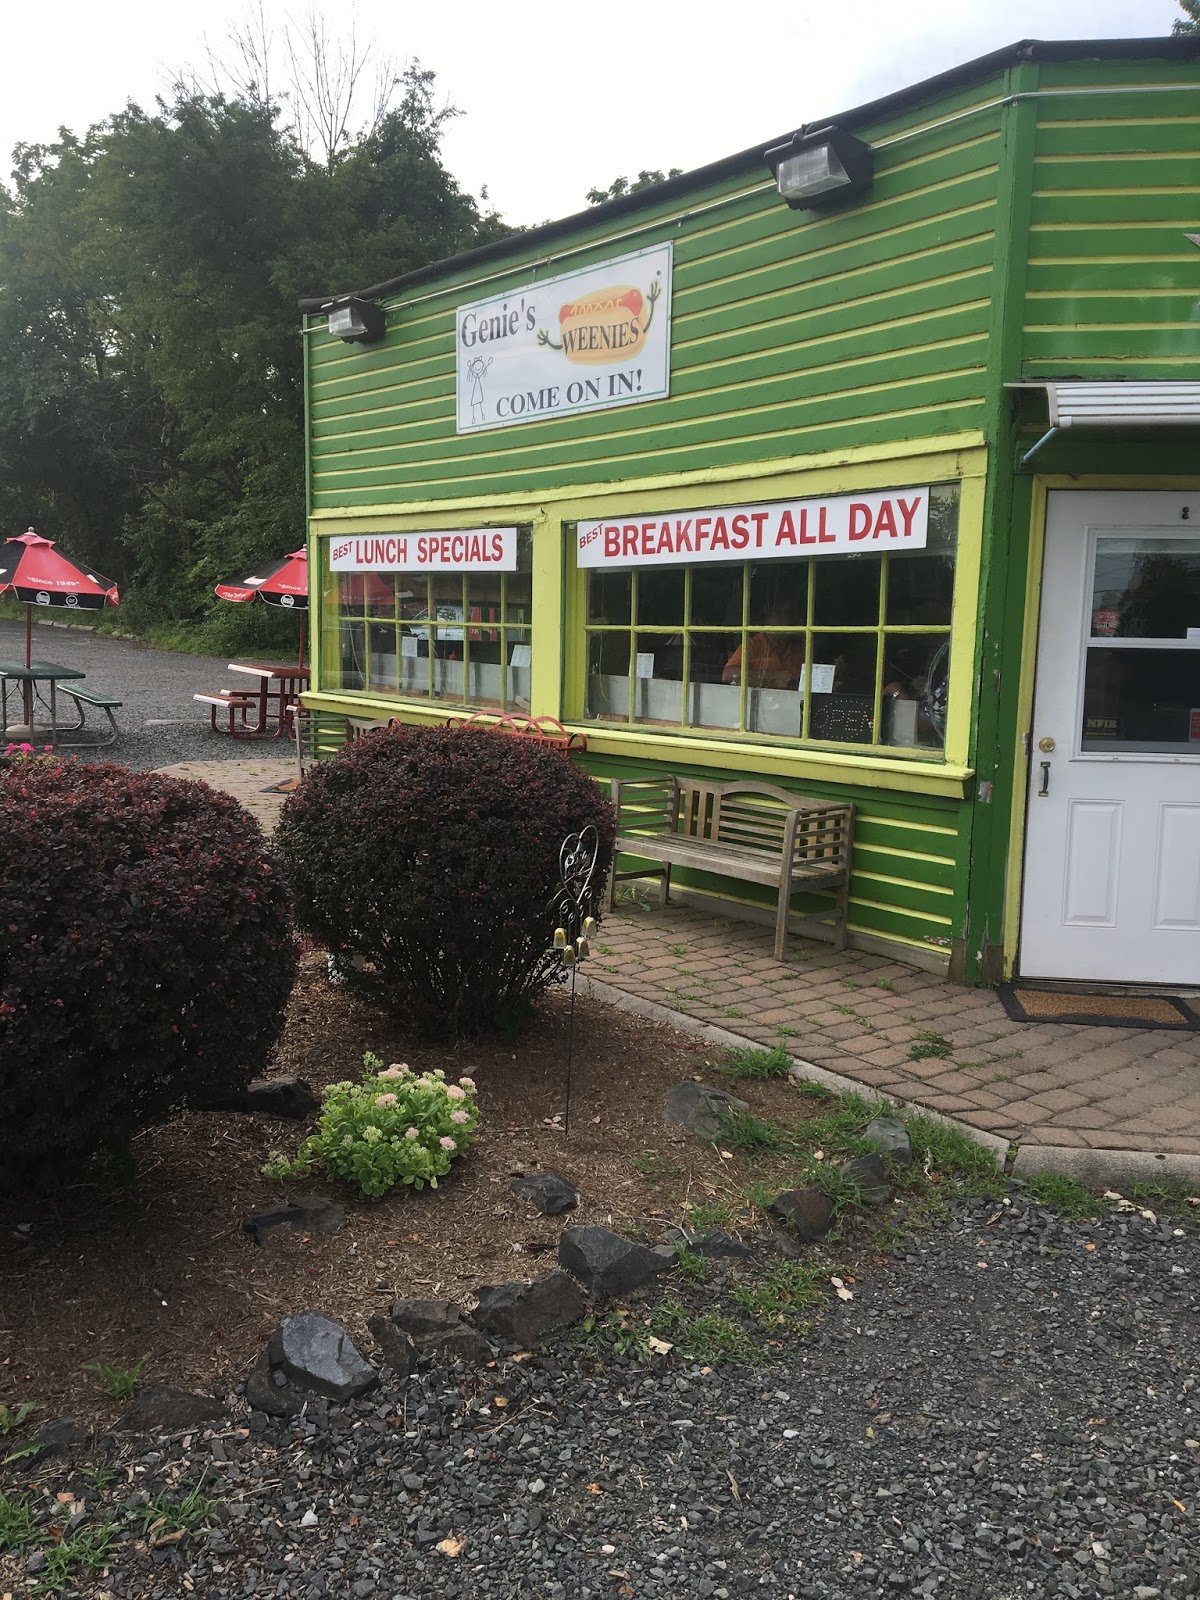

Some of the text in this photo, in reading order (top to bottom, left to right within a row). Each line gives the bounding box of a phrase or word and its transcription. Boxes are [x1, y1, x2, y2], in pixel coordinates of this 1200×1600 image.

[461, 298, 536, 348] Genie's
[562, 317, 640, 355] WEENIES
[496, 368, 642, 418] COME ON IN!
[332, 533, 504, 564] BEST LUNCH SPECIALS
[579, 496, 922, 558] BEST BREAKFAST ALL DAY
